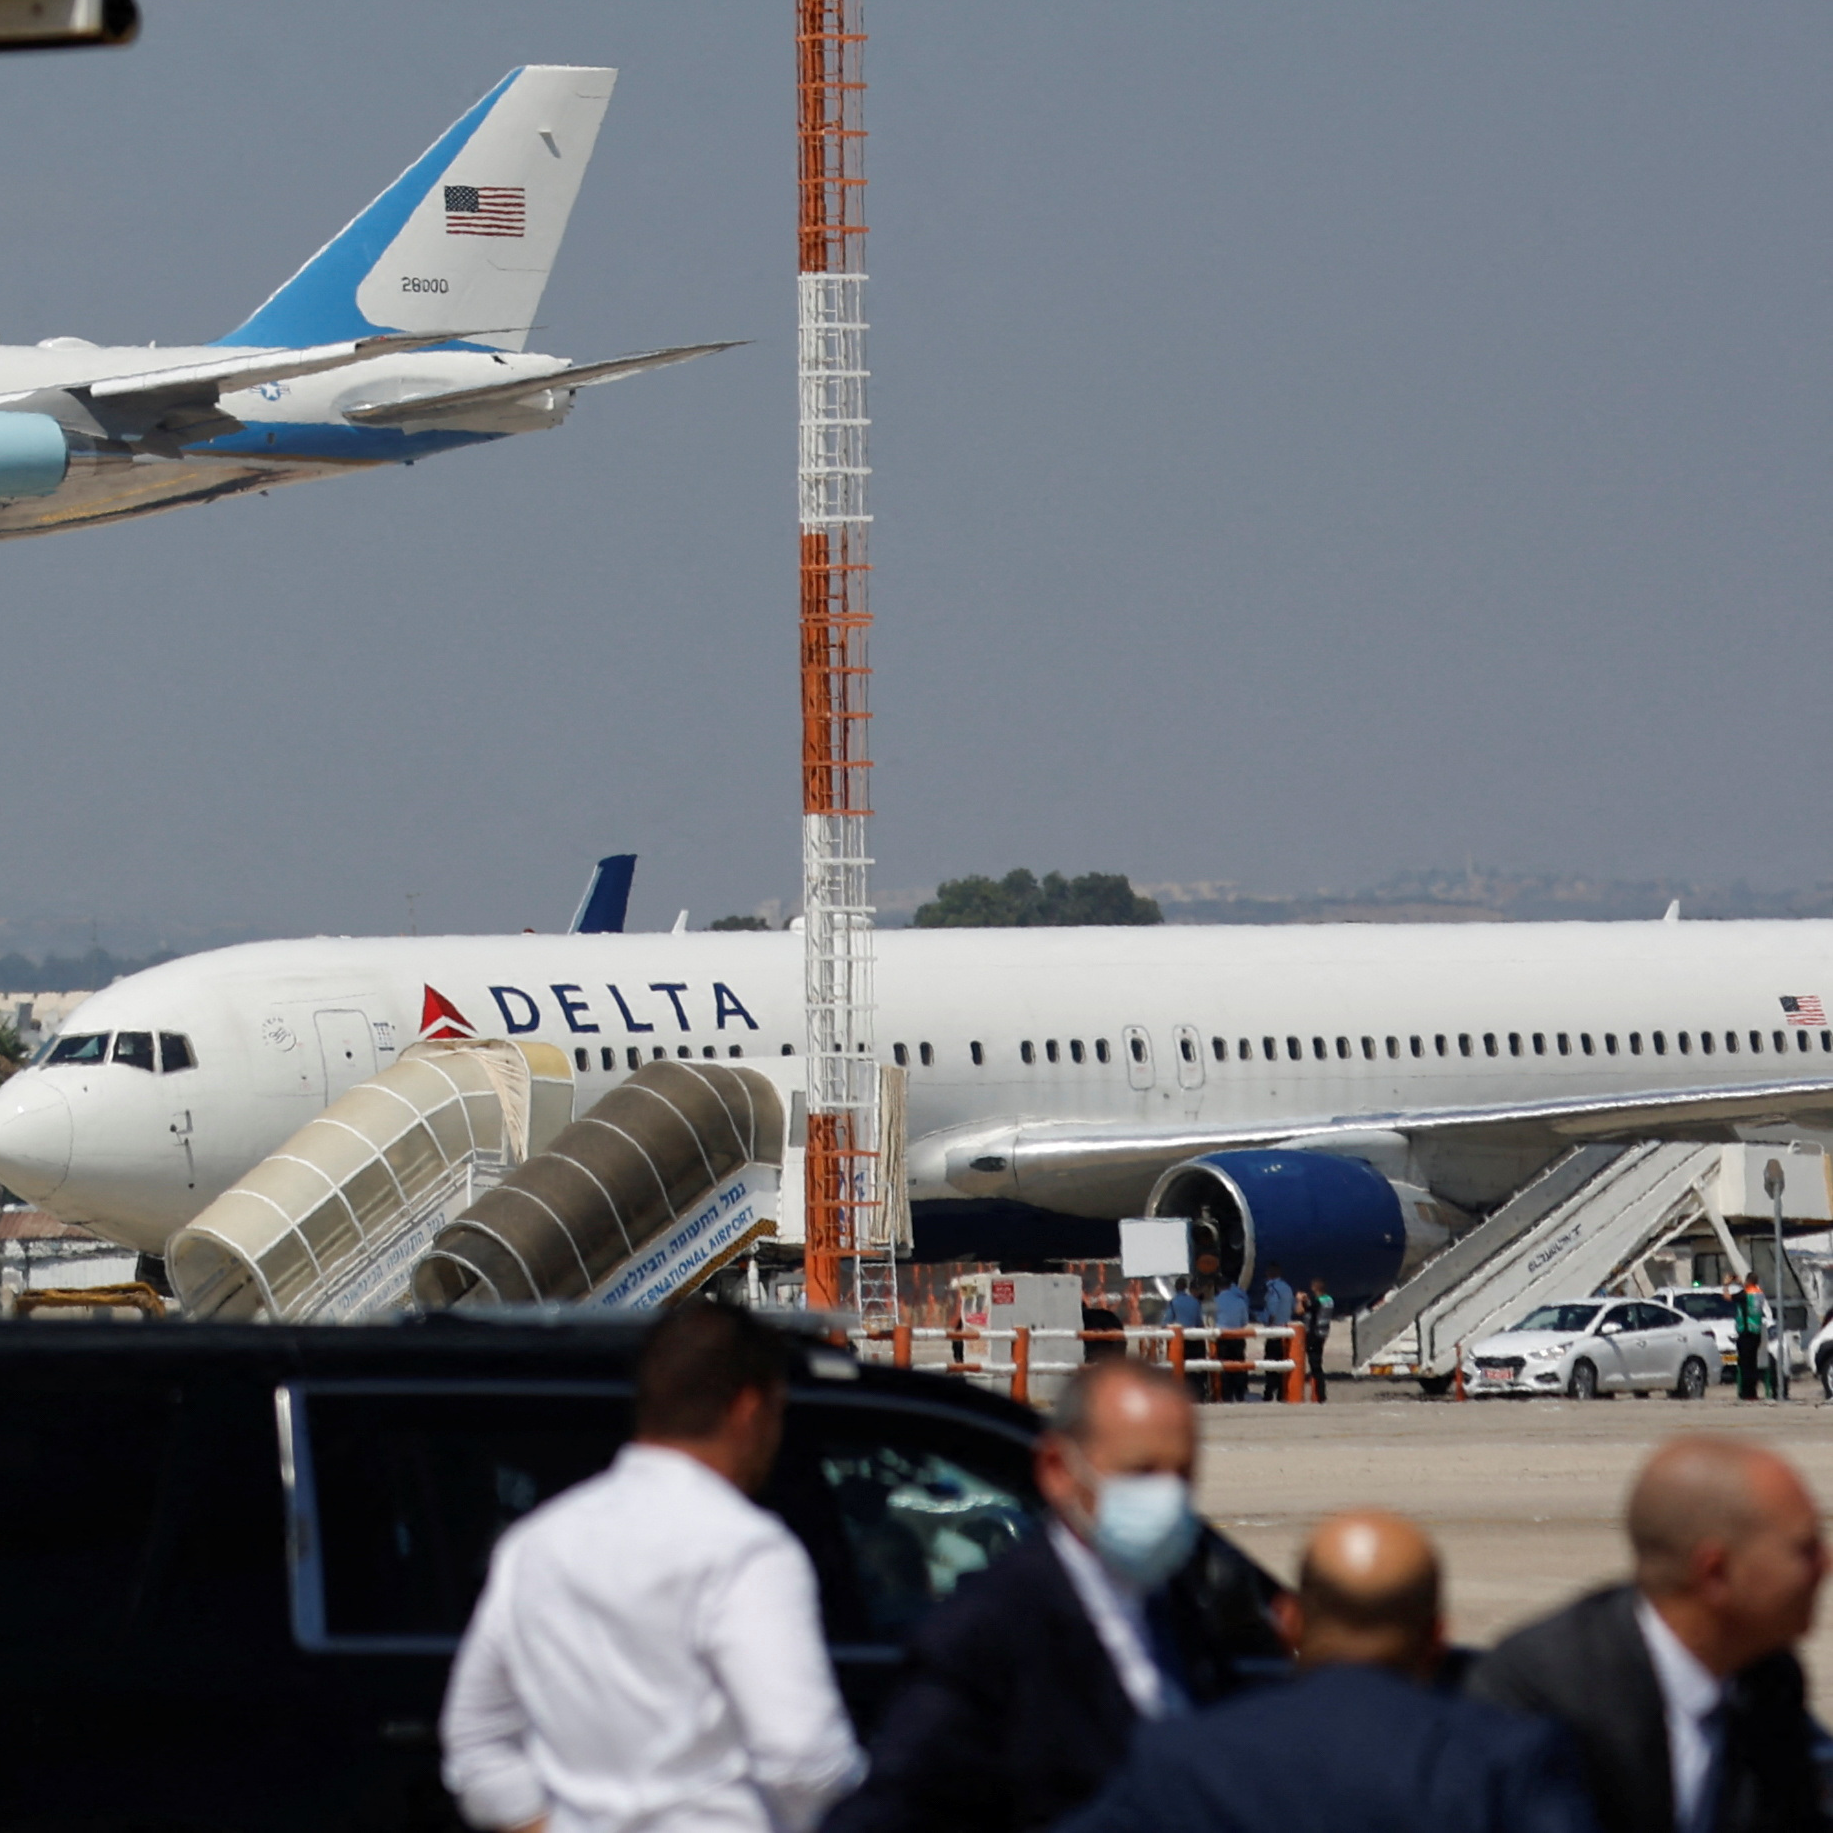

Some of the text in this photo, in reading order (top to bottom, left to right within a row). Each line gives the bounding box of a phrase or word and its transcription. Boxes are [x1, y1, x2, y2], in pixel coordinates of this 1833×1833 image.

[401, 276, 450, 293] 28000
[487, 981, 760, 1034] DELTA
[632, 1205, 755, 1311] TERNATIONAL AIRPORT
